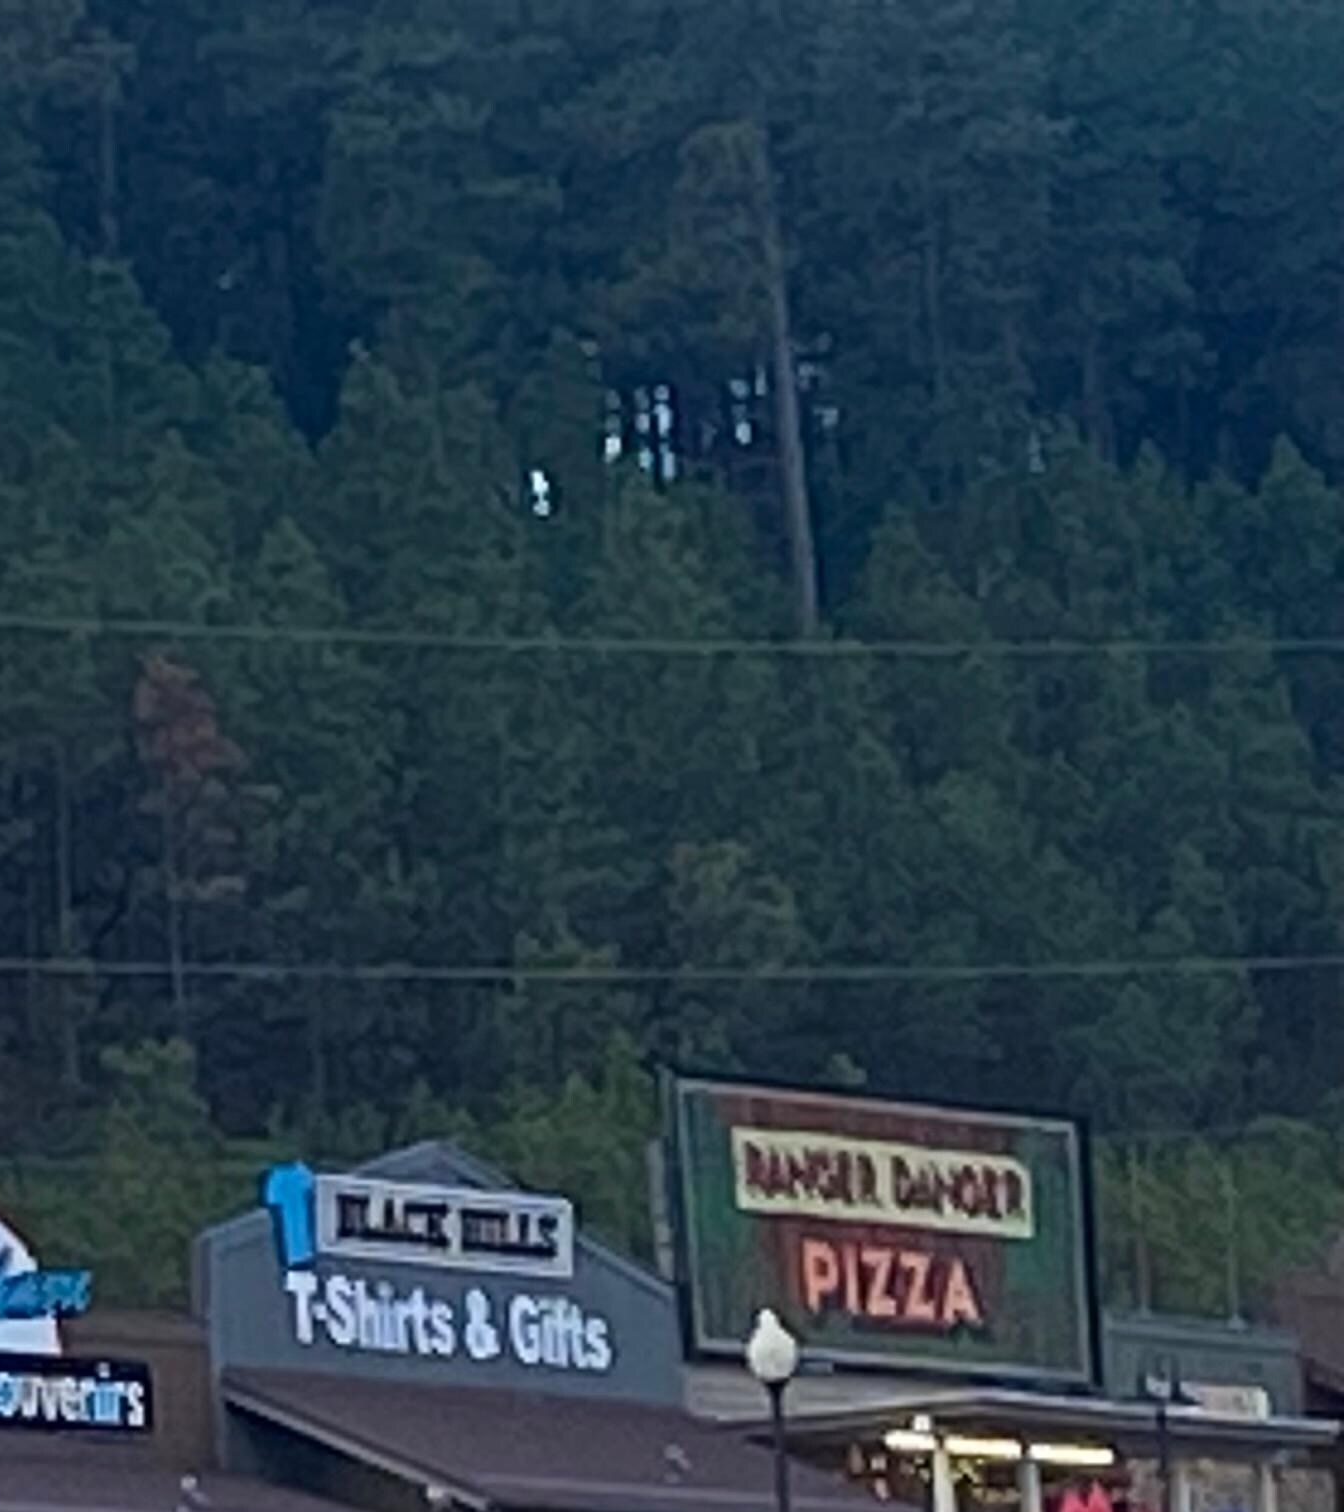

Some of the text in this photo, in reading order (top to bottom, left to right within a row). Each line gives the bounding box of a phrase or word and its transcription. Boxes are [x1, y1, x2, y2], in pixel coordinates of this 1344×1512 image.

[285, 1271, 612, 1370] T-Shirts & Gifts
[802, 1237, 984, 1326] PIZZA
